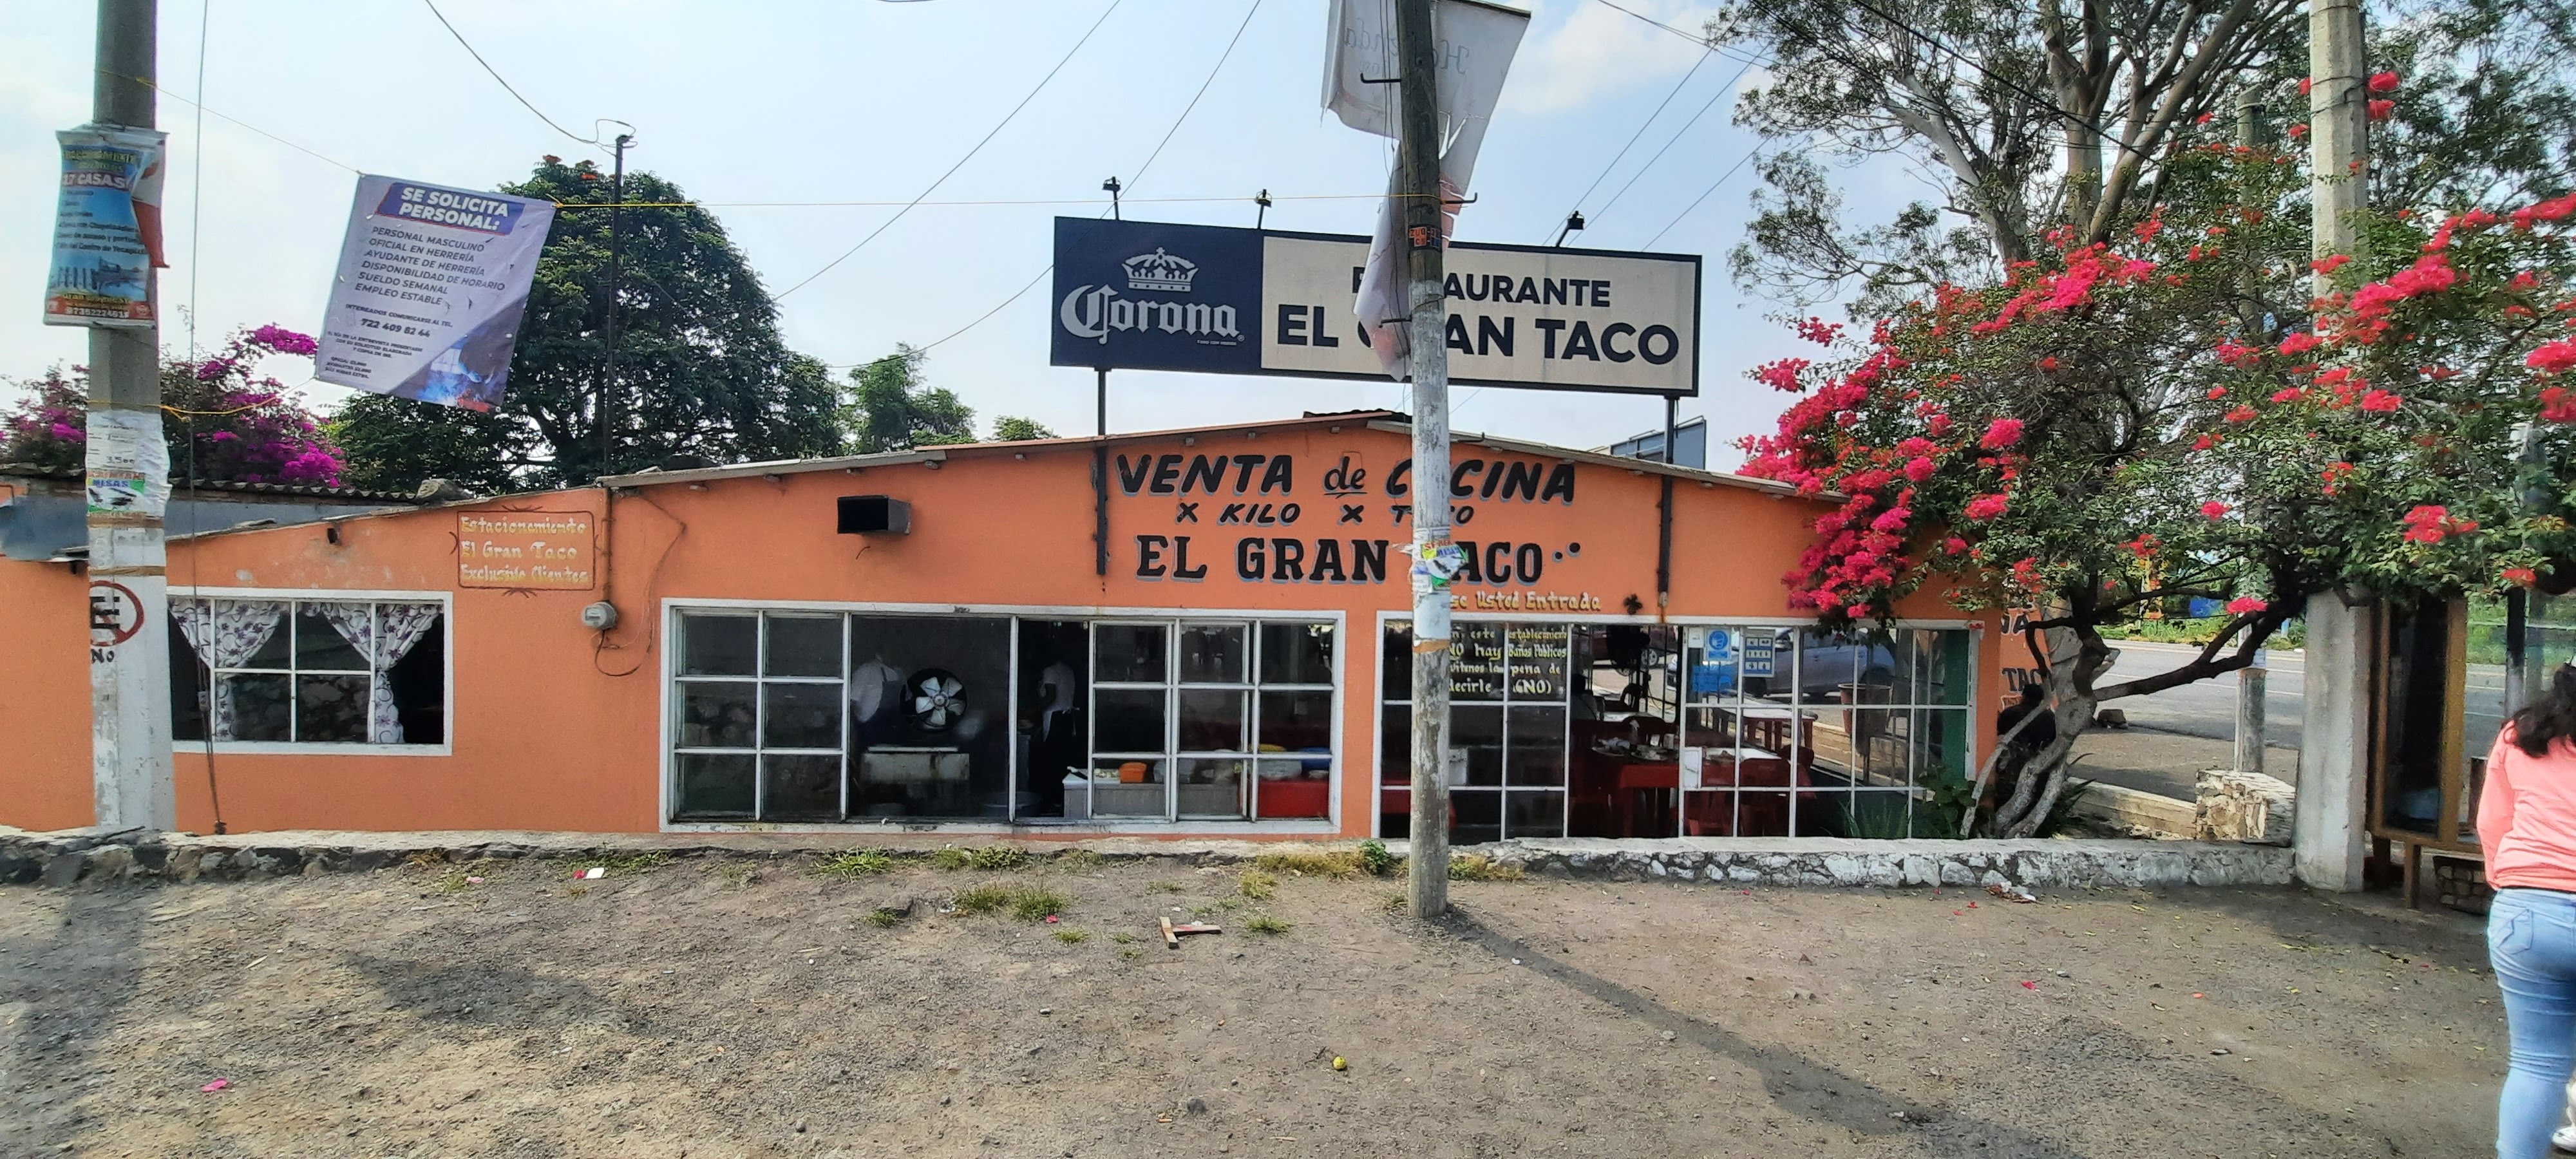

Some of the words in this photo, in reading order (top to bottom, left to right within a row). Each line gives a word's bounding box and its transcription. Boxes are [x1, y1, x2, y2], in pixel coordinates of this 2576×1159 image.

[401, 187, 425, 202] SE
[427, 191, 508, 217] SOLICITA
[399, 202, 500, 231] PERSONAL:
[368, 238, 406, 251] OFICIAL
[410, 245, 424, 254] EN
[426, 248, 474, 262] HERRERÍA
[372, 226, 424, 242] PERSONAL
[426, 236, 484, 252] MASCULINO
[364, 250, 420, 265] AYUDANTE
[421, 259, 437, 268] DE
[437, 261, 484, 276] HERRERÍA
[358, 272, 401, 285] SUELDO
[402, 279, 449, 294] SEMANAL
[361, 260, 444, 281] DISPONIBILIDAD
[446, 276, 460, 284] DE
[460, 278, 505, 290] HORARIO
[354, 283, 399, 297] EMPLEO
[400, 291, 443, 306] ESTABLE
[1354, 267, 1611, 308] AURANTE
[361, 318, 381, 329] 722
[382, 323, 402, 333] 409
[1061, 284, 1240, 345] Corona
[1278, 304, 1339, 347] EL
[1358, 314, 1514, 357] AN
[1535, 318, 1680, 366] TACO
[1116, 454, 1293, 495] VENTA
[1323, 456, 1367, 492] de
[1386, 458, 1576, 504] CCINA
[460, 516, 587, 534] Estacionamiento
[1220, 503, 1301, 525] KILO
[1390, 505, 1474, 525] TO
[460, 540, 475, 558] El
[482, 540, 523, 559] Gran
[529, 541, 578, 559] Taco
[1137, 534, 1208, 581] EL
[1237, 536, 1389, 583] GRAN
[1449, 541, 1543, 585] ACO
[531, 564, 589, 583] Clientes
[1475, 590, 1520, 610] Usted
[1525, 590, 1602, 611] Entrada
[1470, 627, 1495, 639] este
[1474, 643, 1502, 661] hay
[1548, 662, 1561, 675] de
